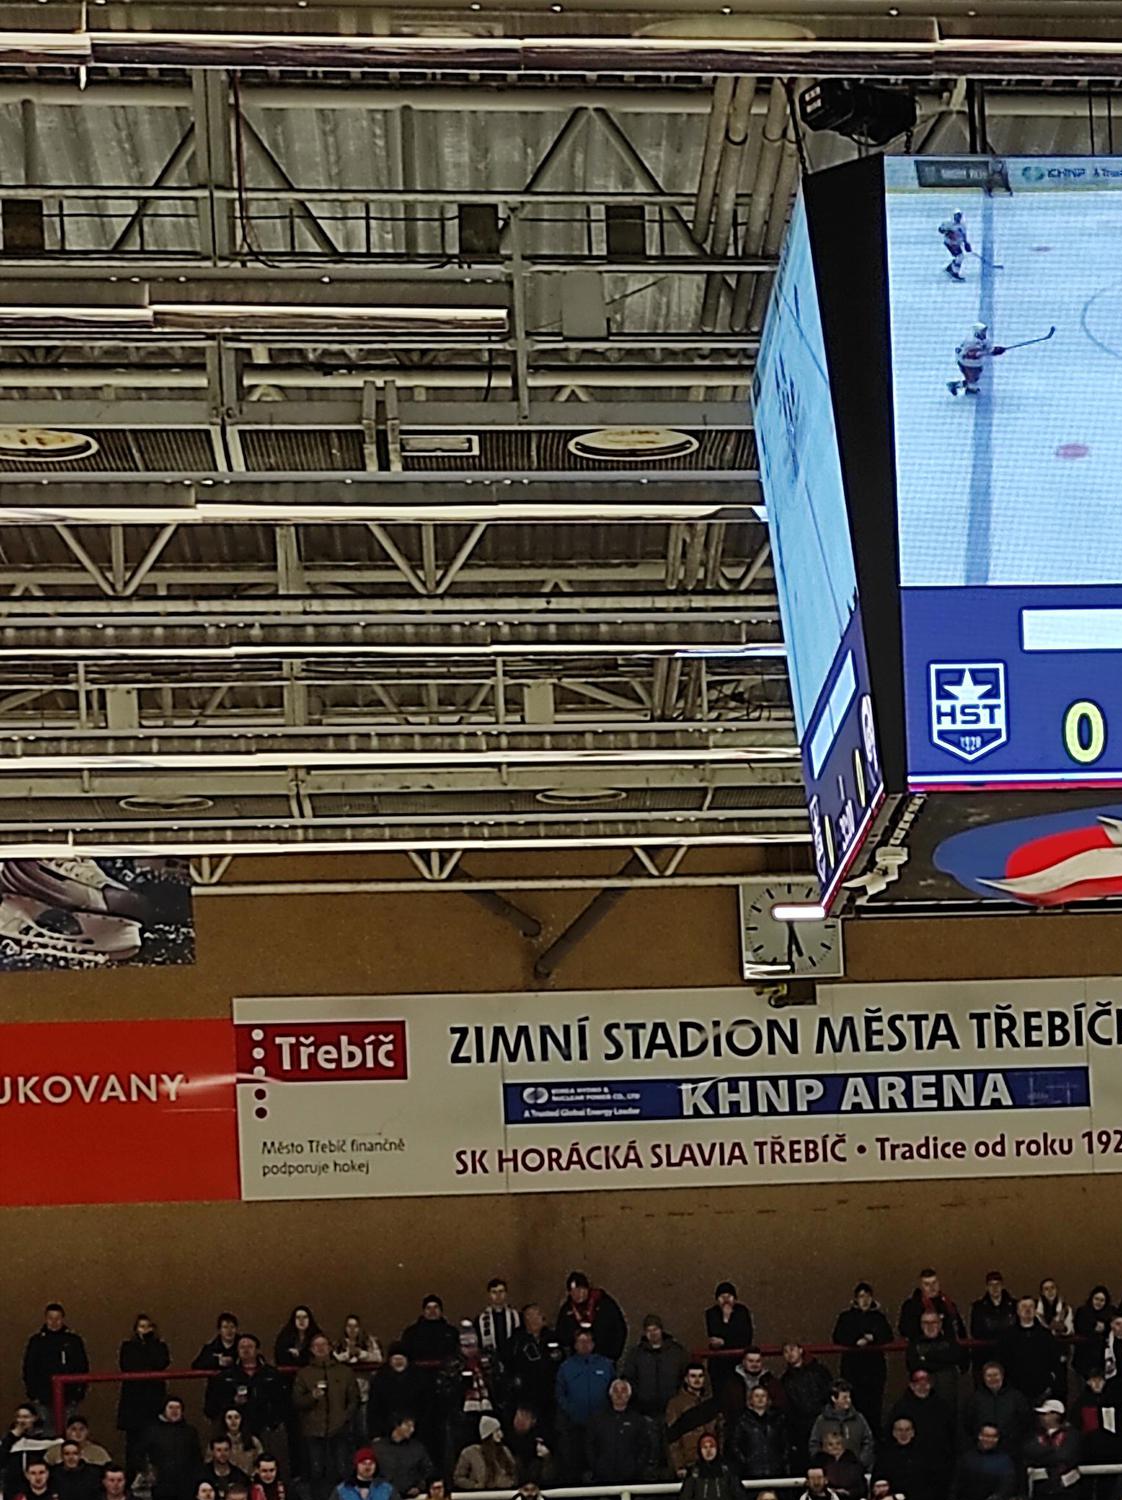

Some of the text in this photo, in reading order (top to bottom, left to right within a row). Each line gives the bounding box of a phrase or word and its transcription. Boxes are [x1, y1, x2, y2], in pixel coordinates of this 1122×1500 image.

[936, 703, 1001, 725] HST
[1065, 701, 1104, 763] 0
[275, 1034, 395, 1071] Třebíč
[450, 1016, 590, 1065] ZIMNÍ
[603, 1018, 799, 1061] STADION
[815, 1007, 960, 1055] MĚSTA
[682, 1073, 1013, 1116] KHNP ARENA
[261, 1137, 405, 1156] Město Třebíč finančně
[455, 1149, 489, 1175] SK
[498, 1140, 644, 1174] HORÁCKÁ
[650, 1140, 748, 1169] SLAVIA
[754, 1133, 847, 1165] TŘEBÍČ
[875, 1135, 966, 1161] Tradice
[974, 1133, 1006, 1159] od
[1014, 1132, 1073, 1157] roku
[261, 1159, 370, 1178] podporuje hokej
